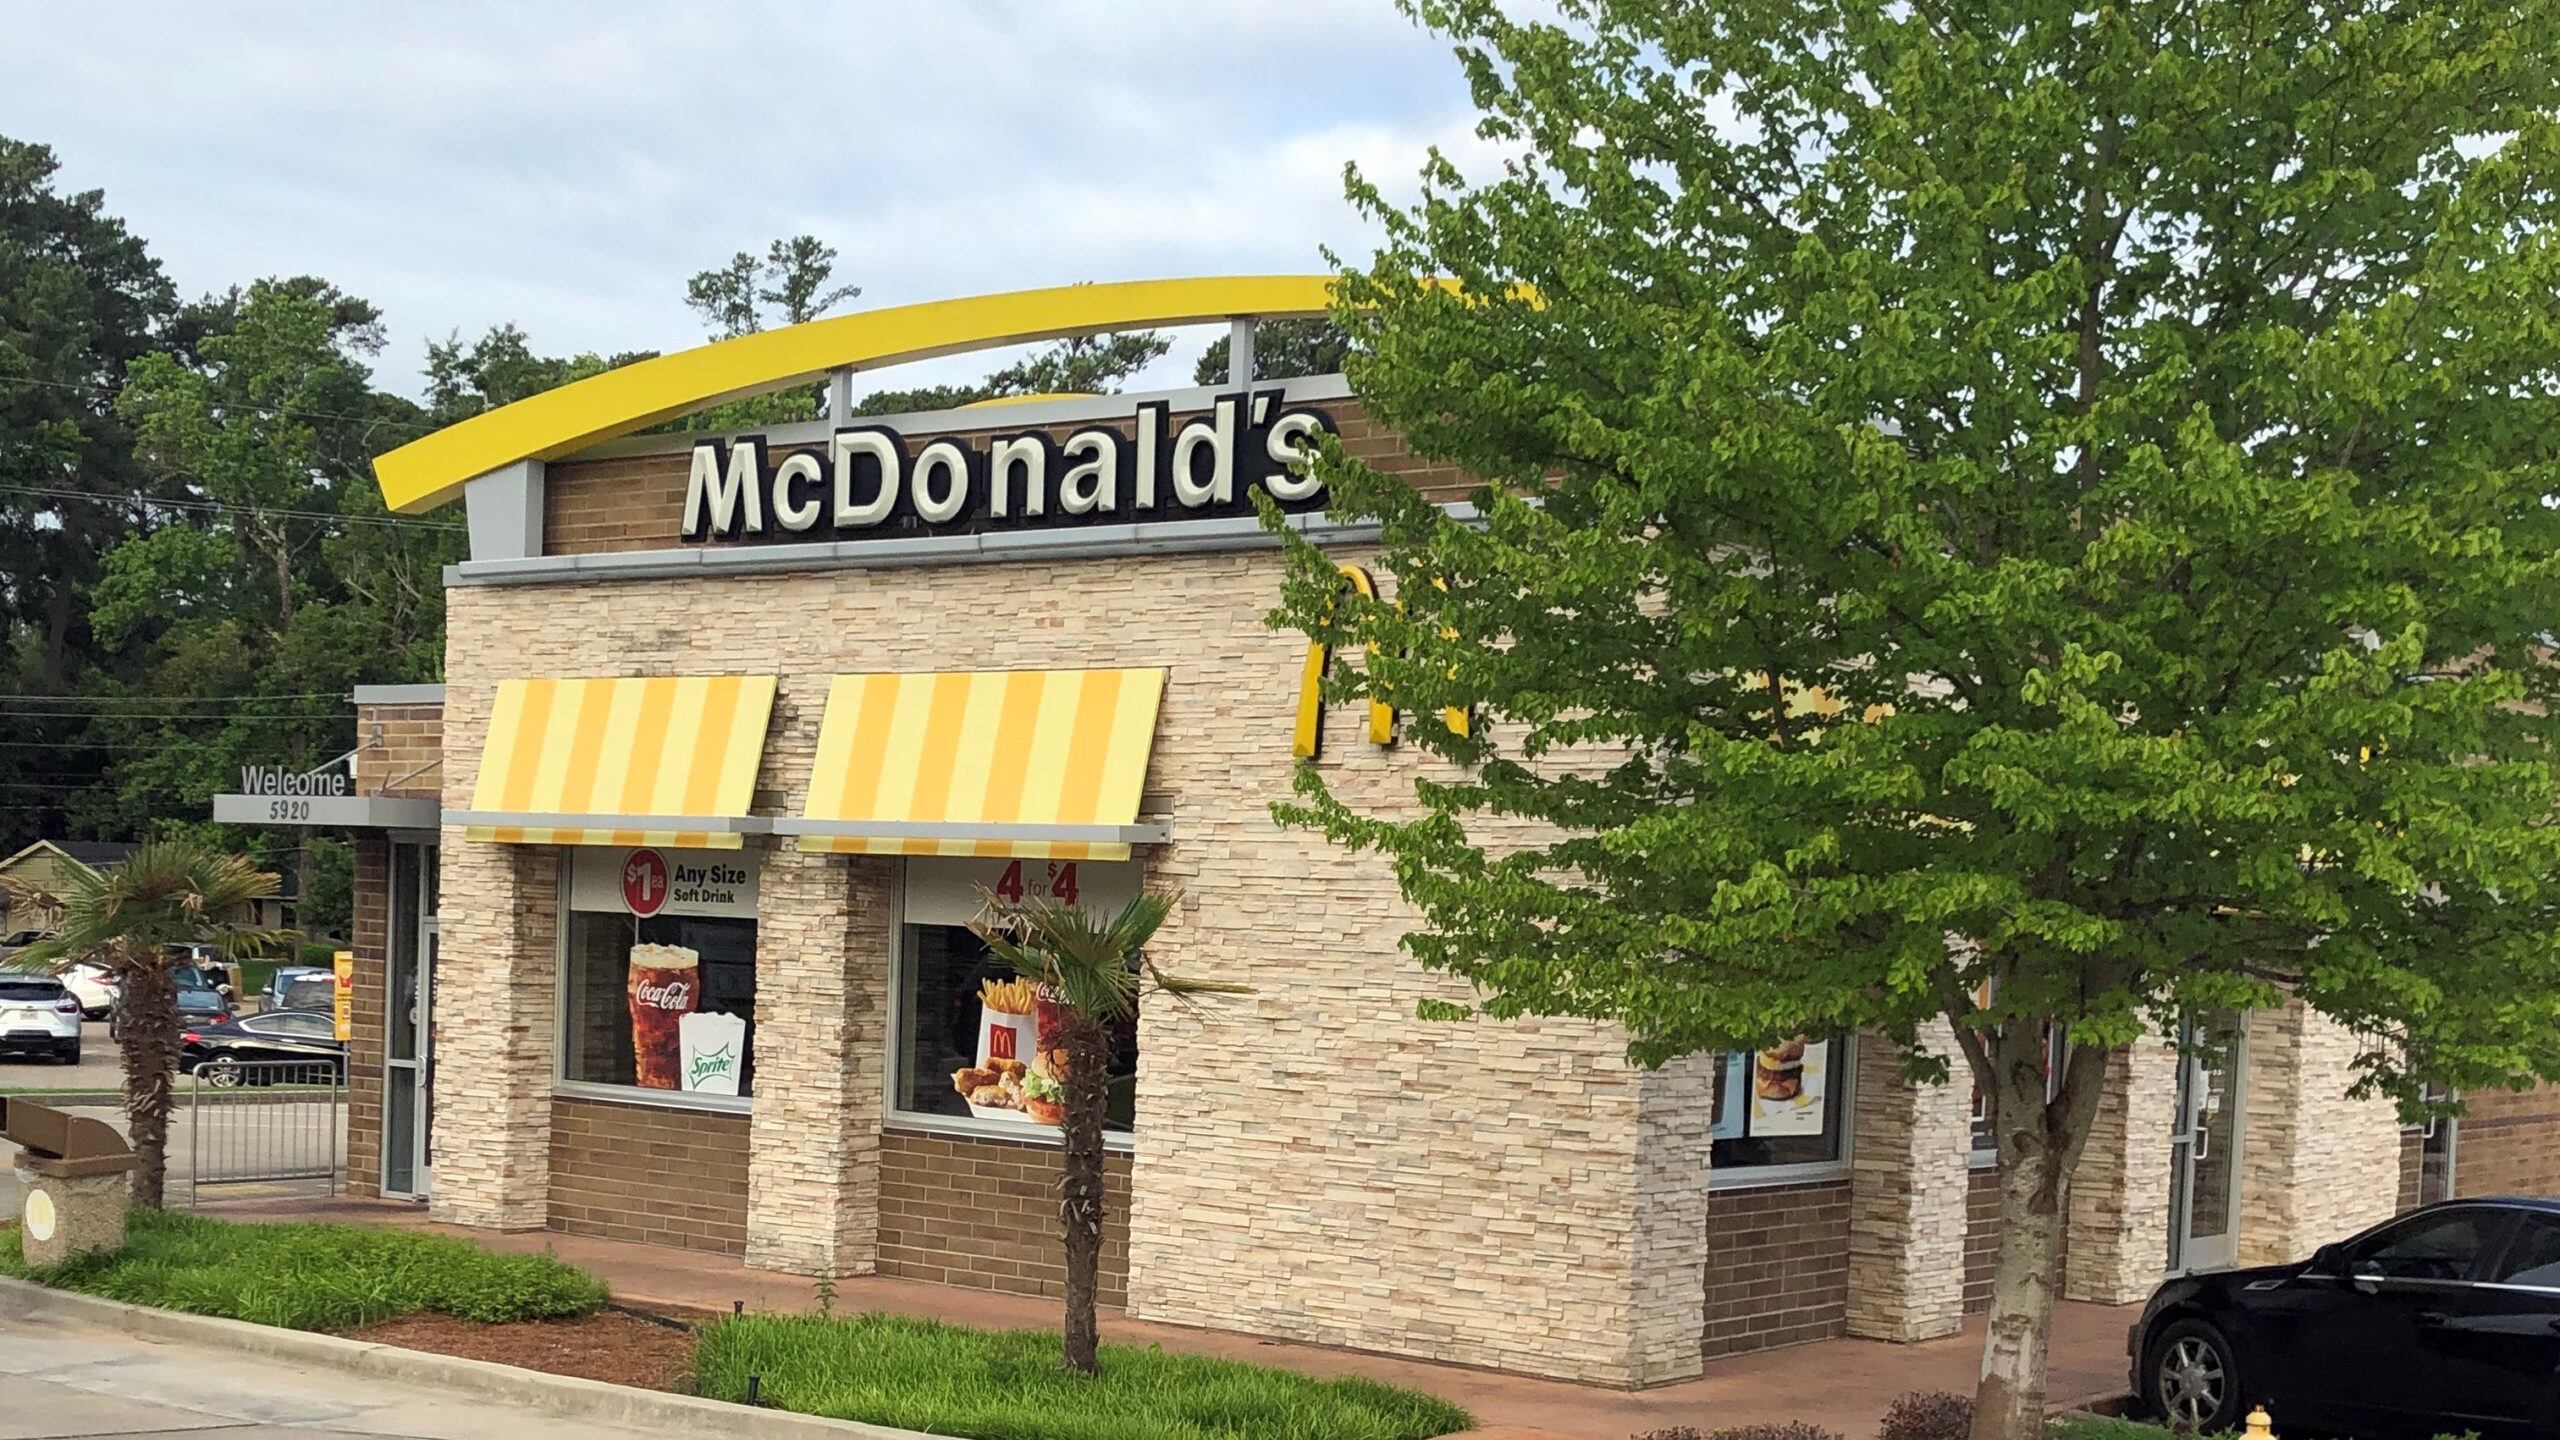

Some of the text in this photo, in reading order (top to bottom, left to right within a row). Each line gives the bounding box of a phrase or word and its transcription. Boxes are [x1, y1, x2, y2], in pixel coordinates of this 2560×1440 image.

[682, 395, 1325, 537] McDonald's
[241, 765, 345, 796] Welcome
[269, 800, 309, 820] 5920
[674, 863, 746, 888] Any Size
[997, 860, 1079, 906] 4 for $4
[674, 888, 735, 904] Soft Drink
[691, 1056, 731, 1077] Sprite
